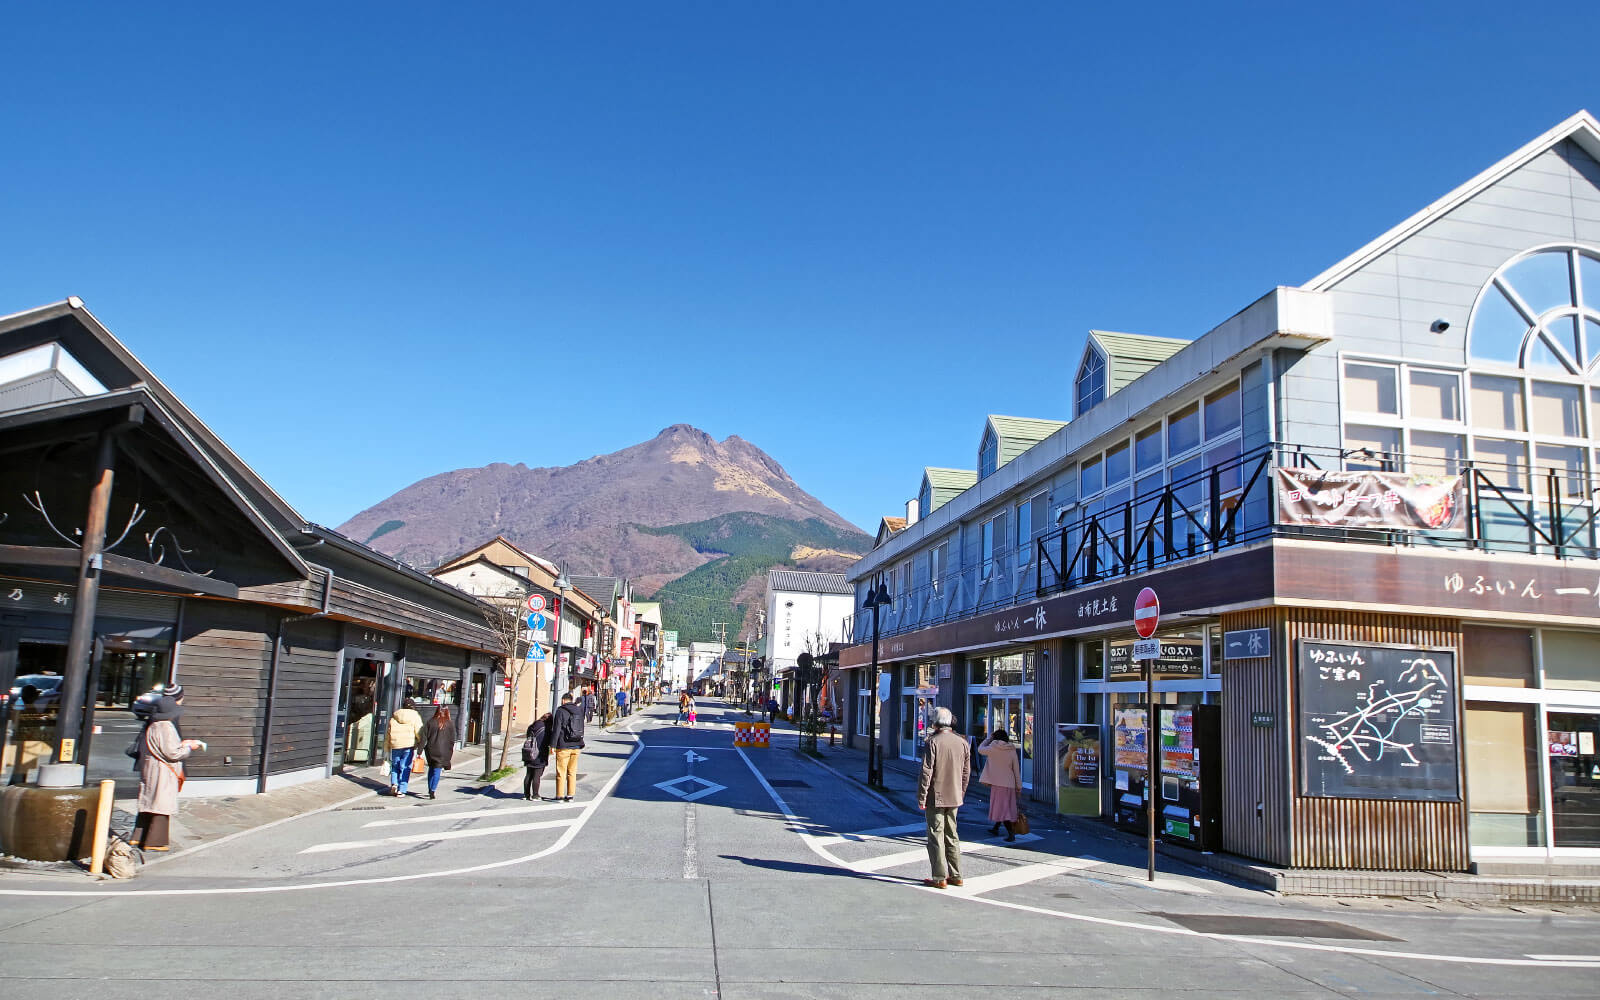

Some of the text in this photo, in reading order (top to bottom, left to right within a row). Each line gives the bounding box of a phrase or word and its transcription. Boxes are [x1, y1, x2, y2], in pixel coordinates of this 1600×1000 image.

[1444, 572, 1543, 599] ゆふいん
[532, 599, 542, 608] 30
[1023, 605, 1048, 631] 一休
[1229, 632, 1263, 655] 一休
[1310, 649, 1365, 666] ゆふいん
[1319, 666, 1360, 681] ご案内
